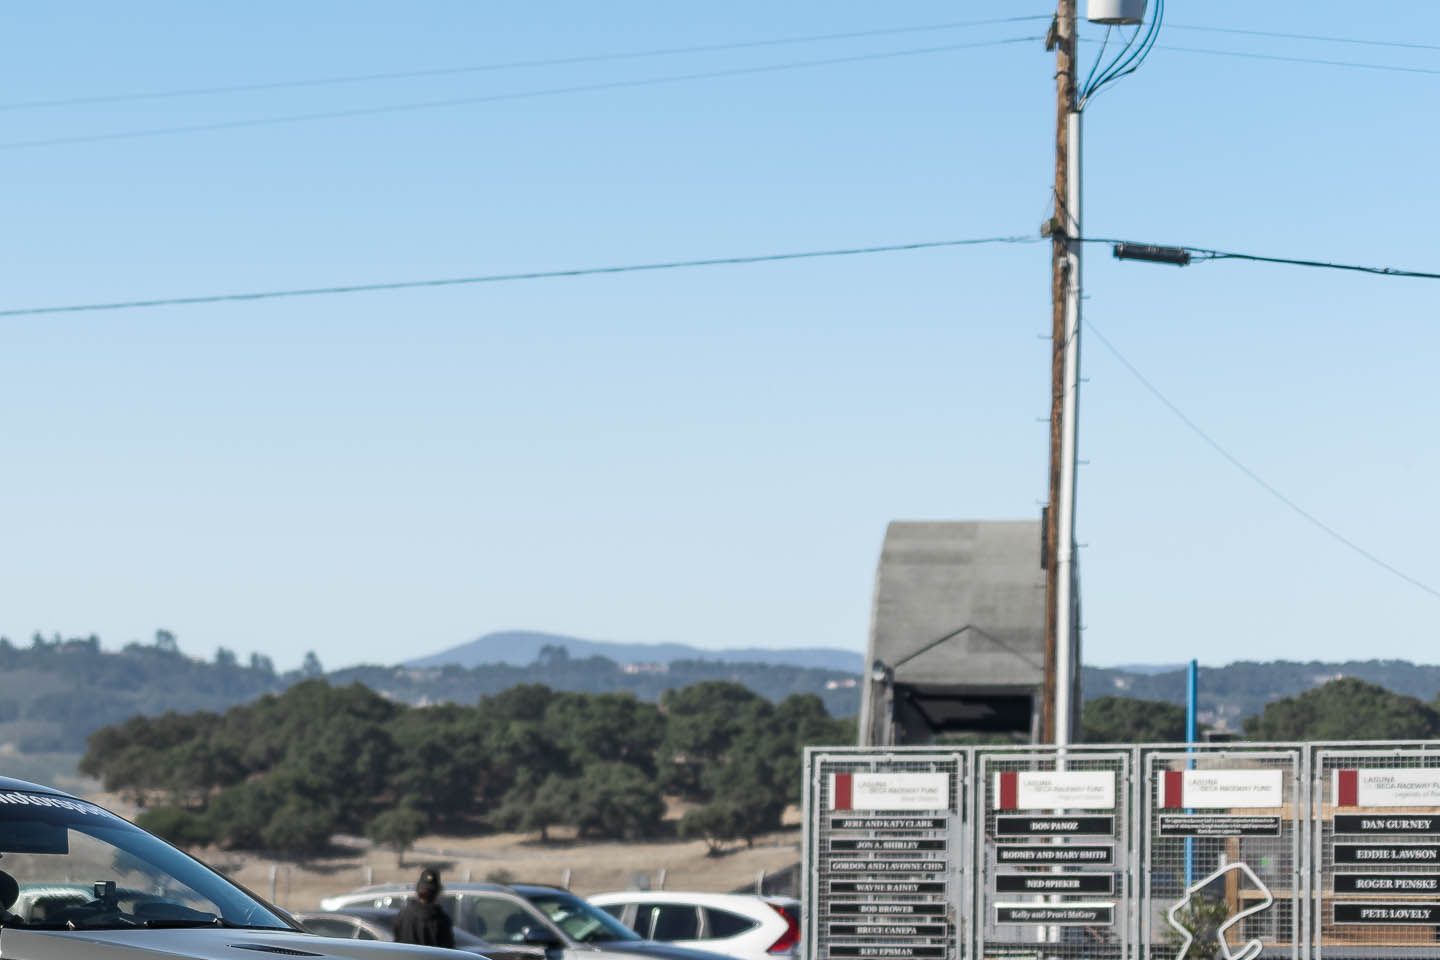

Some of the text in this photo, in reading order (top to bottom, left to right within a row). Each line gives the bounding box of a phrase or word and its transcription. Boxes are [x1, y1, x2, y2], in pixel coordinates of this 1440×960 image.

[865, 820, 883, 828] AND
[906, 820, 933, 828] CLARK
[1031, 822, 1050, 830] DON
[1361, 820, 1433, 829] DAN GURNEY
[856, 841, 872, 849] JON
[883, 841, 919, 849] SHIRLEY
[1002, 850, 1107, 859] RODNEY AND MARY SMITH
[1356, 850, 1437, 859] EDDIE LAWSON
[832, 862, 866, 870] GORDON
[867, 862, 885, 870] AND
[923, 862, 944, 870] CHIN
[1027, 880, 1045, 888] NED
[1356, 880, 1438, 889] ROGER PENSKE
[860, 905, 914, 913] BOB BROWER
[1011, 911, 1031, 920] Kelly
[1031, 911, 1046, 919] and
[1361, 909, 1432, 918] PETE LOVELY
[857, 926, 917, 934] BRUCE CANEPA
